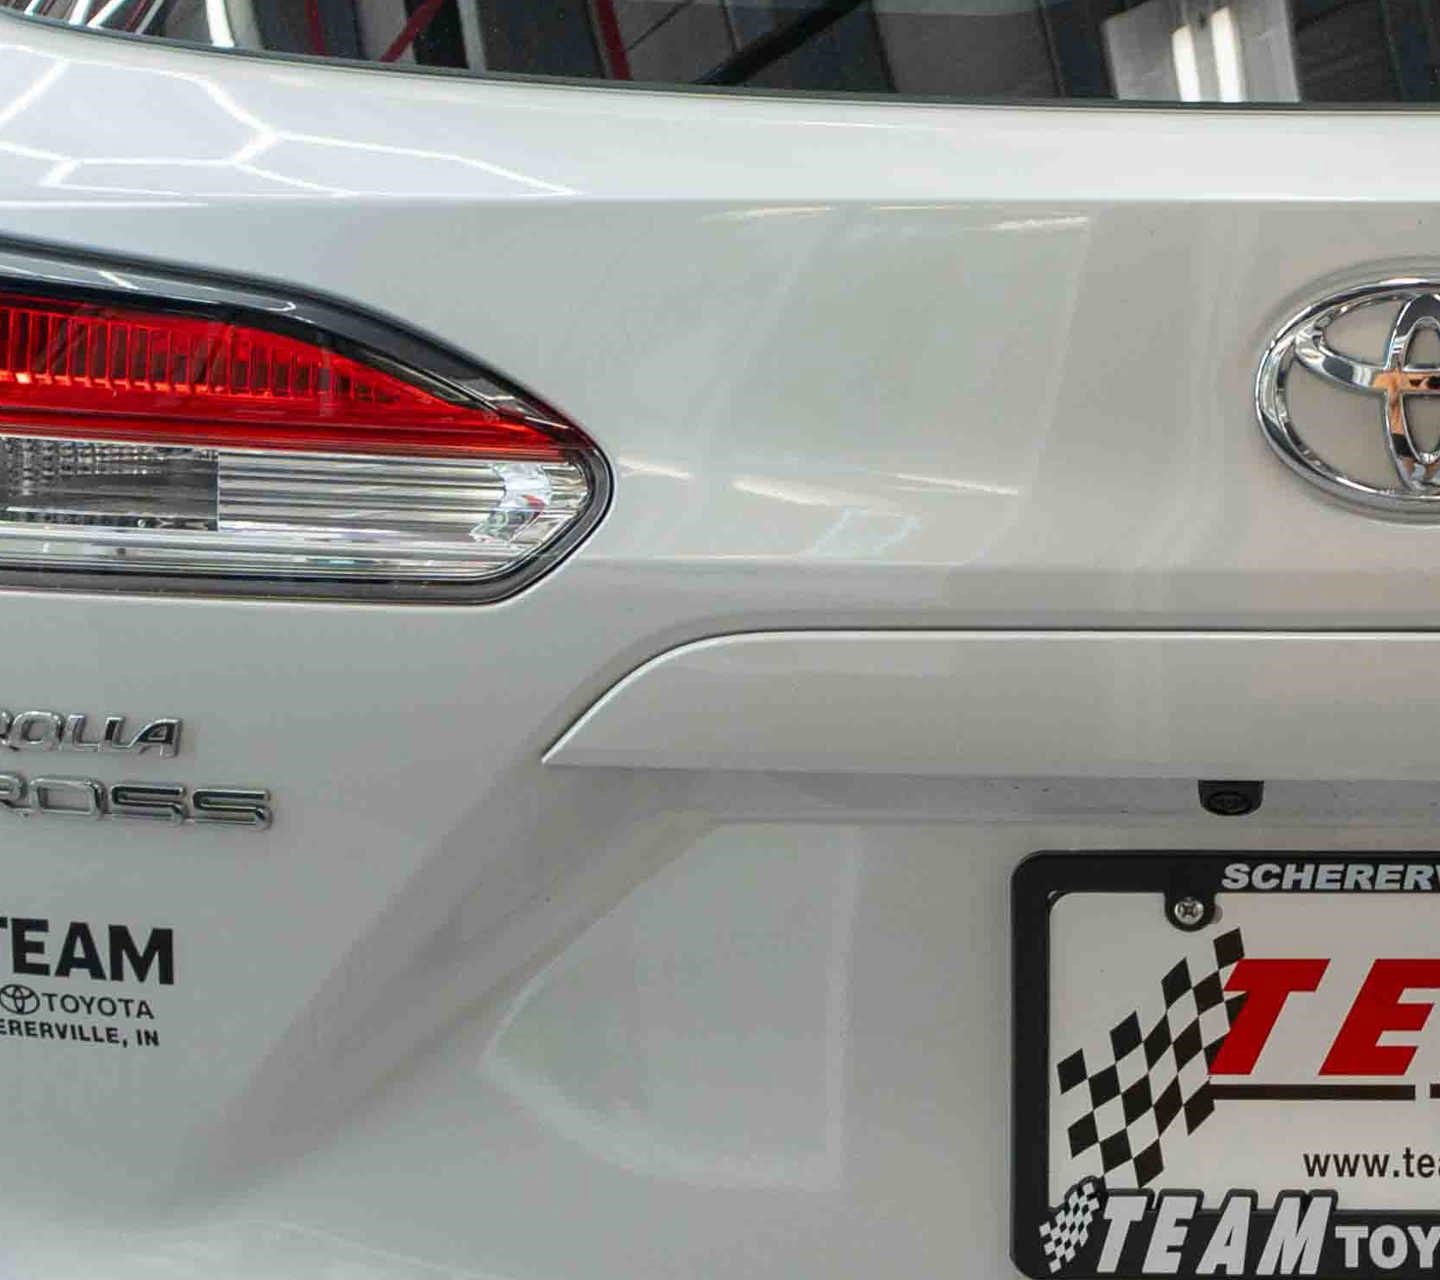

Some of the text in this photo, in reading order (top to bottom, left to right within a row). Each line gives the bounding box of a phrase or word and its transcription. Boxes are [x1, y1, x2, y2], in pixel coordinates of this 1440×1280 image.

[42, 992, 155, 1020] TOYOTA
[136, 1029, 160, 1047] IN
[1096, 1195, 1333, 1275] TEAM
